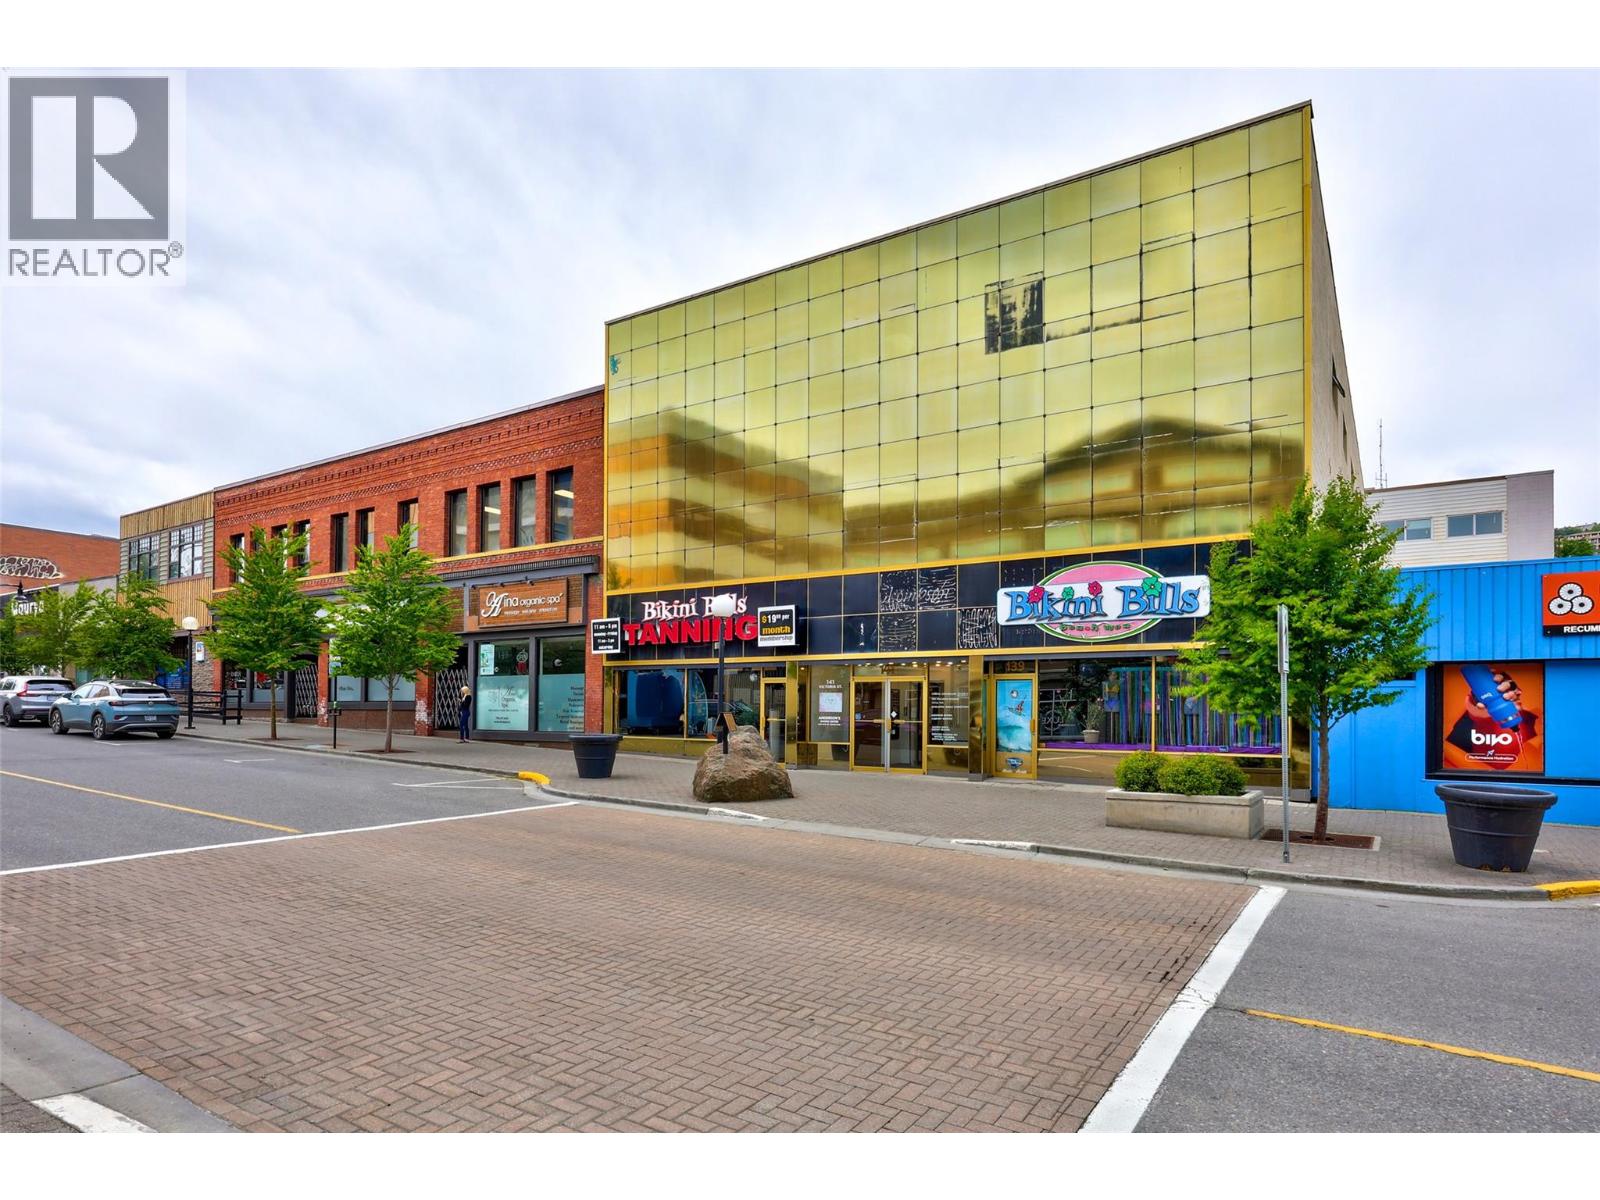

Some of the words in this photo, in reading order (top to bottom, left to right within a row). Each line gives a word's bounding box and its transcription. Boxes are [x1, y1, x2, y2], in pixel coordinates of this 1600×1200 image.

[520, 595, 546, 608] organic
[1004, 581, 1109, 622] Bikini
[1116, 577, 1201, 618] Bills
[641, 599, 699, 622] Bikini
[622, 615, 758, 646] TANNING
[762, 626, 791, 635] month
[1006, 661, 1025, 672] 139
[1470, 729, 1513, 746] bivo
